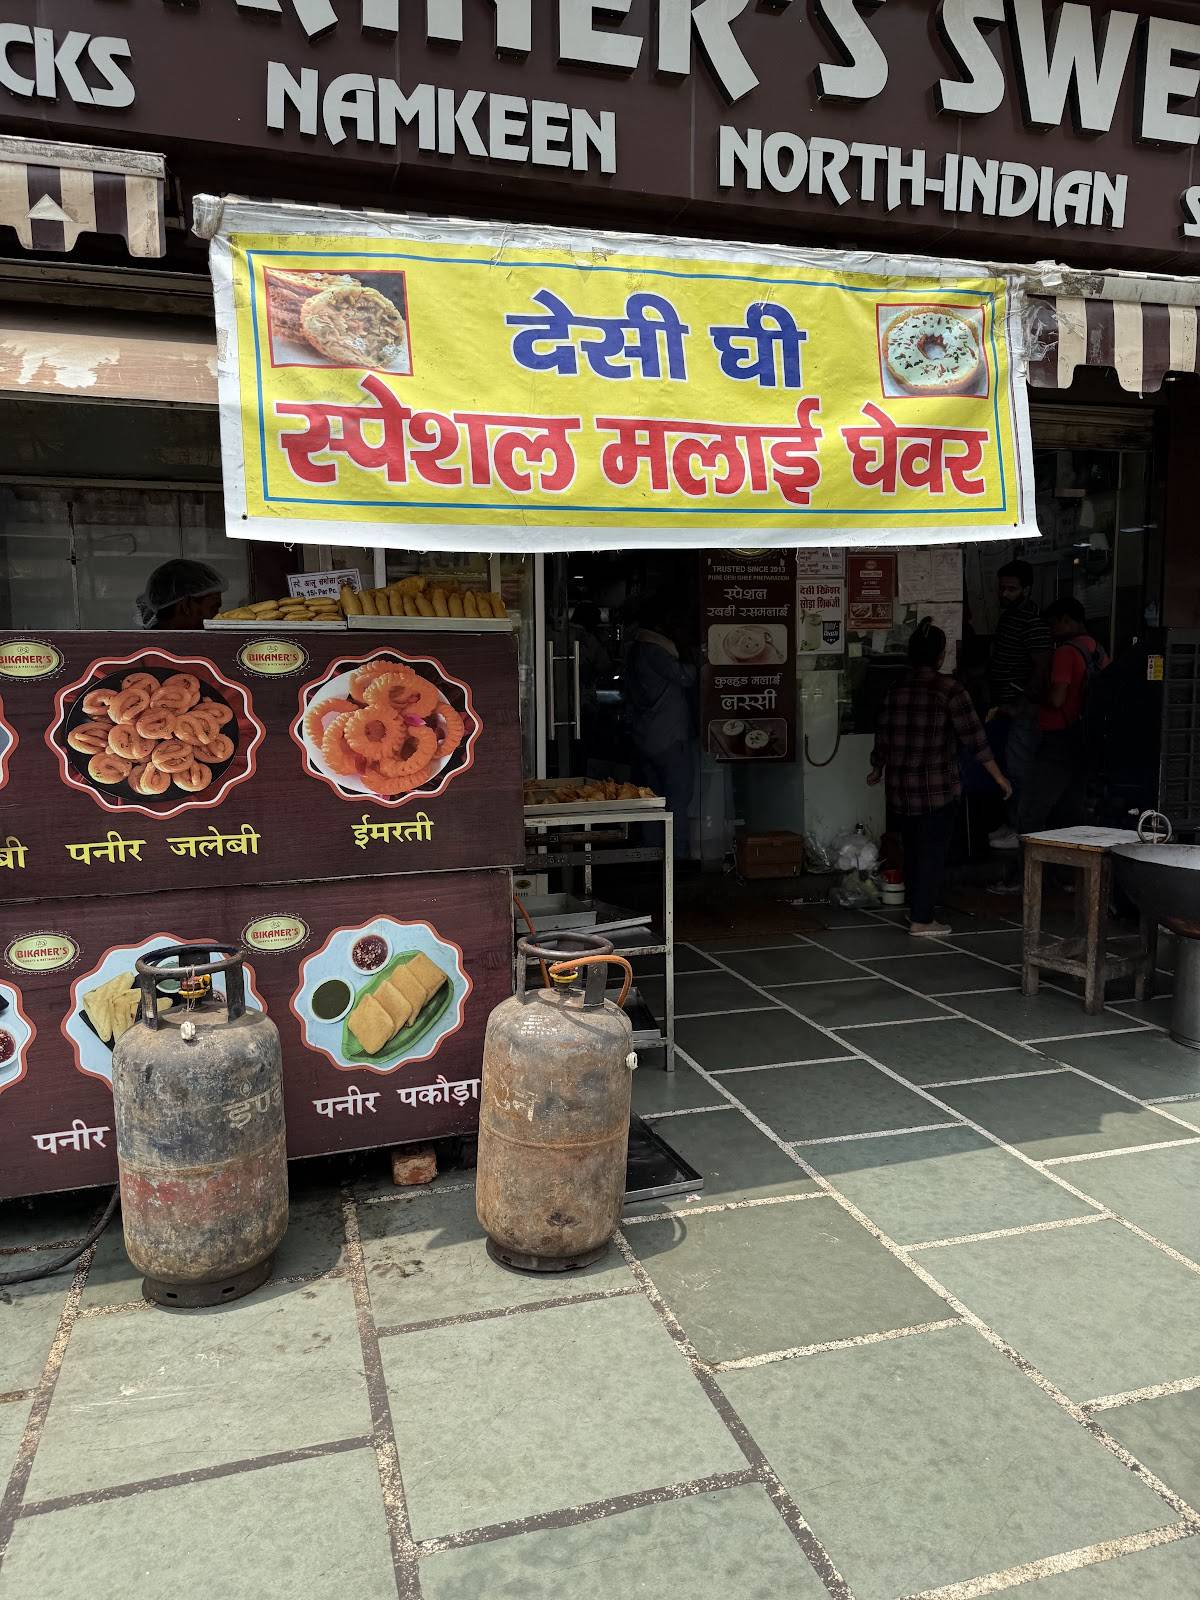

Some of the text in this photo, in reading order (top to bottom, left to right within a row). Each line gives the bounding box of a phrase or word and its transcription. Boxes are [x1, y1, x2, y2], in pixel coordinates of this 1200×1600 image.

[266, 61, 616, 174] NAMKEEN
[719, 125, 1128, 229] NORTH-INDIAN
[506, 290, 807, 388] देसी घी
[275, 374, 989, 505] स्पेशल मलाई घेवर
[712, 565, 746, 573] TRUSTED
[747, 565, 769, 573] SINCE
[722, 585, 768, 600] स्पेशल
[738, 603, 791, 617] रसमलाई
[248, 653, 298, 662] BIKANER'S
[751, 672, 784, 685] मलाई
[720, 688, 778, 711] लस्सी
[65, 823, 262, 866] पनीर जलेबी
[351, 811, 435, 849] ईमरती
[252, 927, 299, 940] BIKANER'S
[16, 946, 69, 959] BIKANER'S
[312, 1085, 382, 1119] पनीर
[396, 1075, 481, 1107] पकौड़ा
[31, 1119, 111, 1154] पनीर
